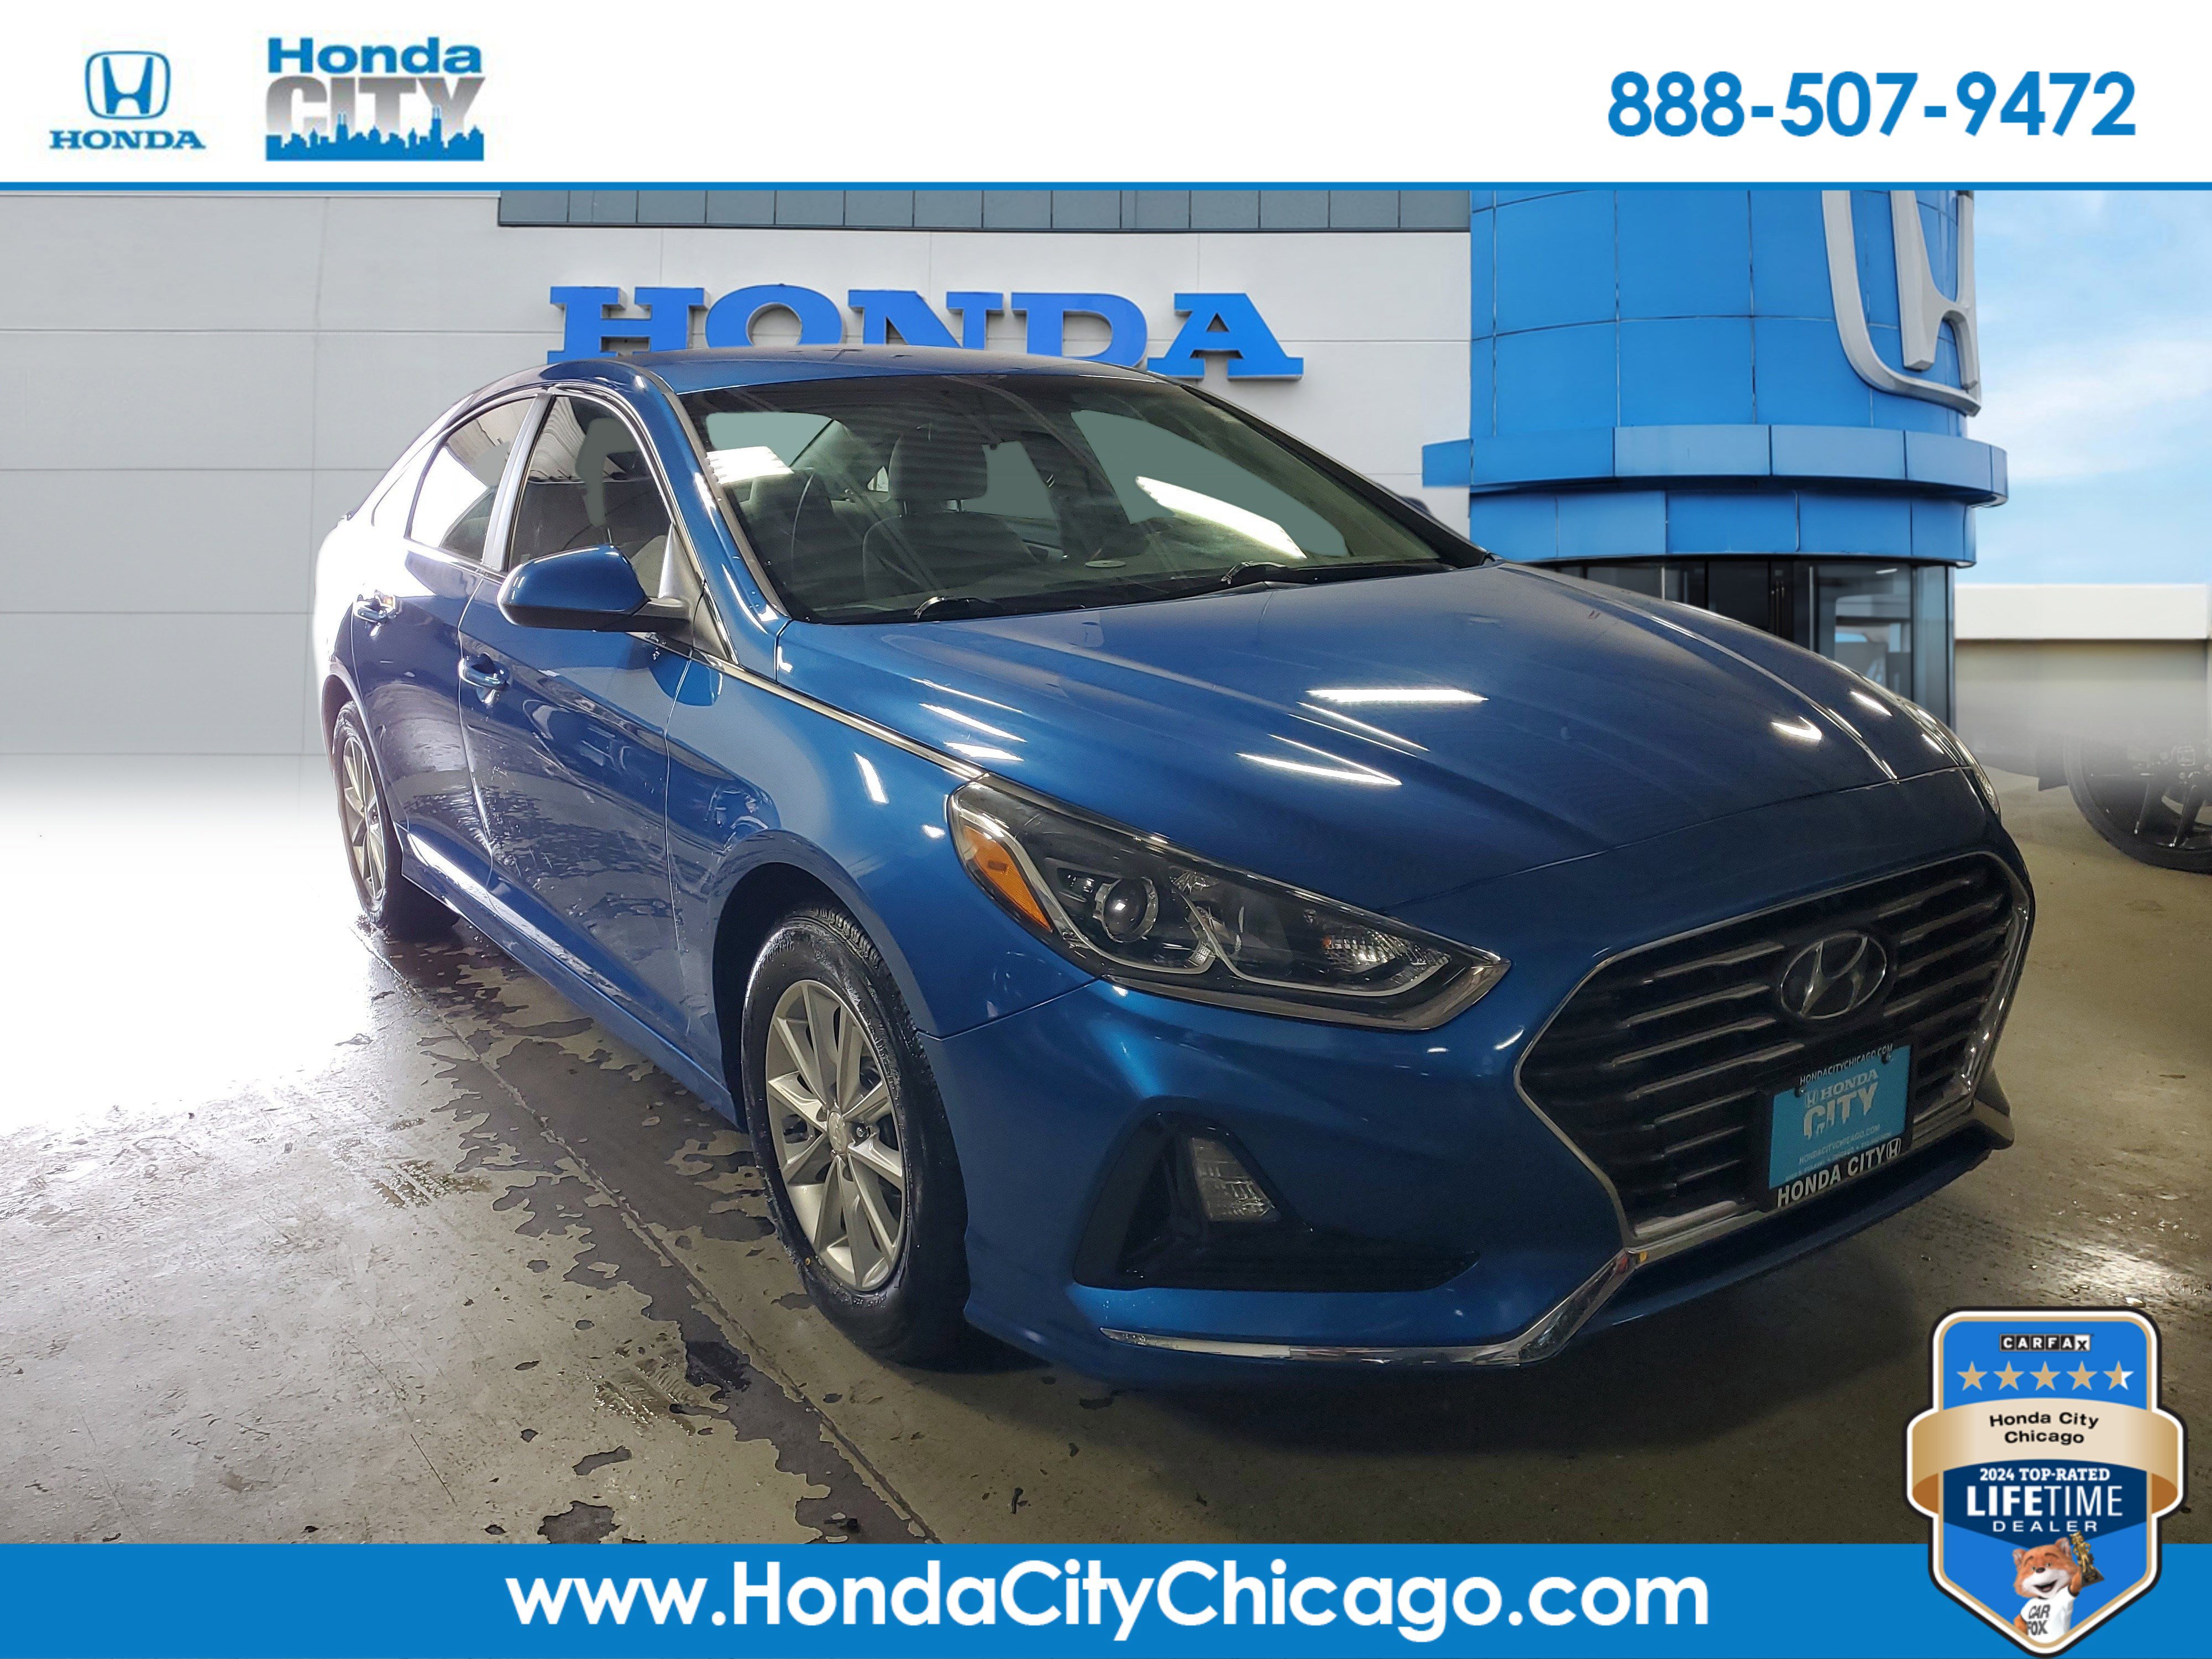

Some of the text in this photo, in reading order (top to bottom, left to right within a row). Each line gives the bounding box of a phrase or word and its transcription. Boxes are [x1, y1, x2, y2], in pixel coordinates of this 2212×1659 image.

[1804, 1082, 1878, 1140] CITY
[1821, 1069, 1878, 1100] HONDA
[1777, 1164, 1841, 1208] HONDA
[1847, 1144, 1886, 1177] CITY
